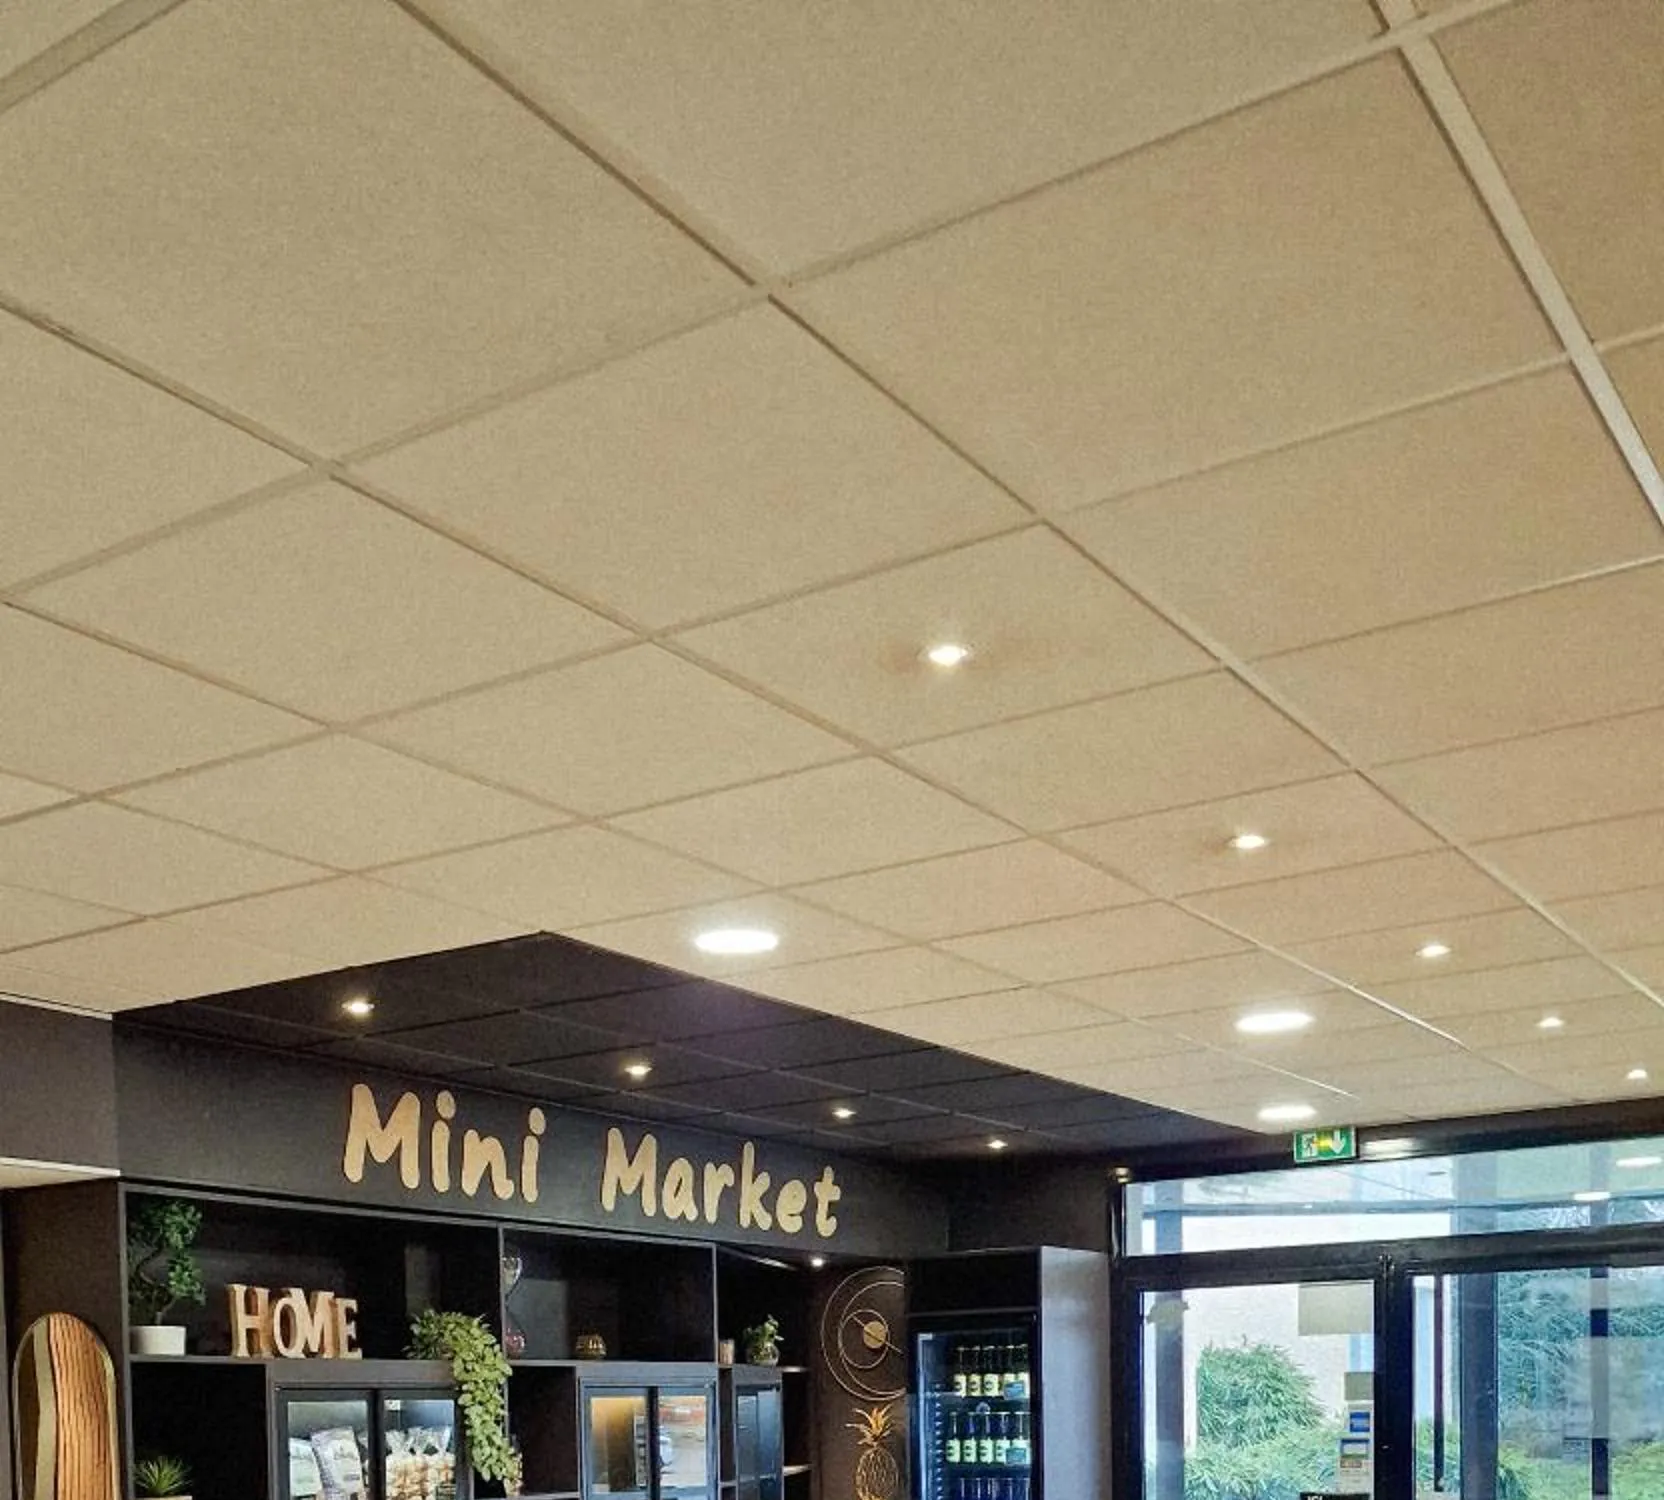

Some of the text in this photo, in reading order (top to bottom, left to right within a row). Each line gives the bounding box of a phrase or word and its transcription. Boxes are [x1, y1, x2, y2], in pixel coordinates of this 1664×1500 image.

[343, 1083, 842, 1238] Mini Market
[226, 1283, 363, 1359] HOME
